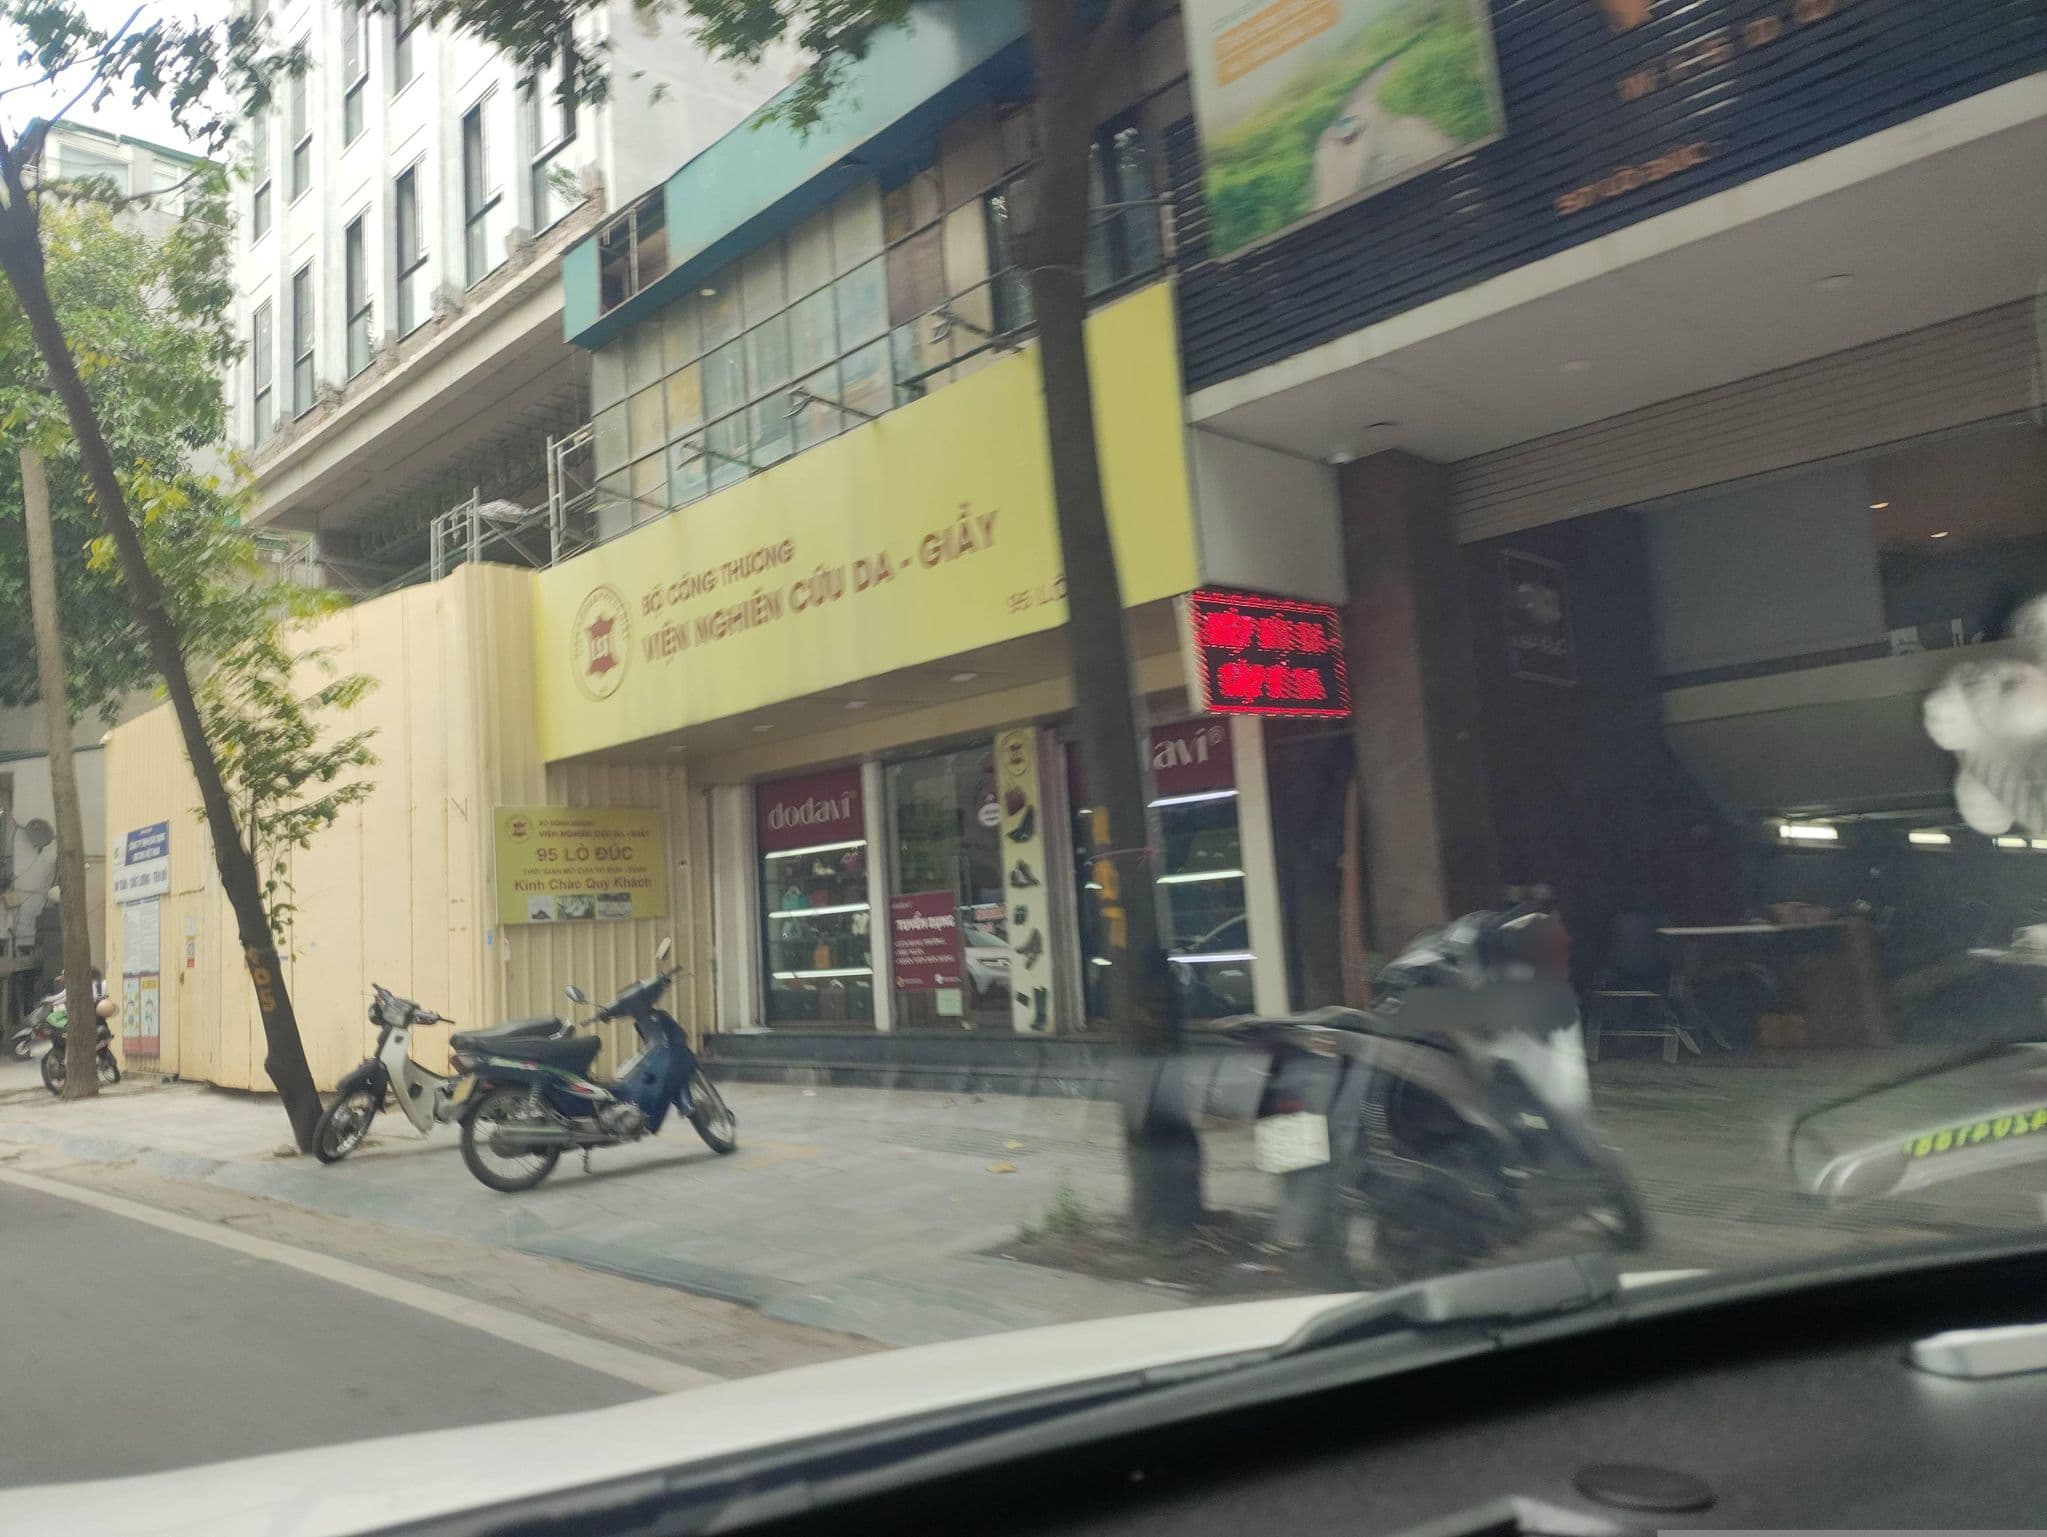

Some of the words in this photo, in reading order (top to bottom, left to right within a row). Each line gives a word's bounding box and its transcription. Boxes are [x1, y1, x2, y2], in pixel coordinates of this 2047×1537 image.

[642, 619, 690, 666] VIỆN
[694, 586, 784, 647] NGHIÊN
[853, 548, 896, 593] DA
[536, 847, 559, 861] 95
[563, 842, 590, 862] LÒ
